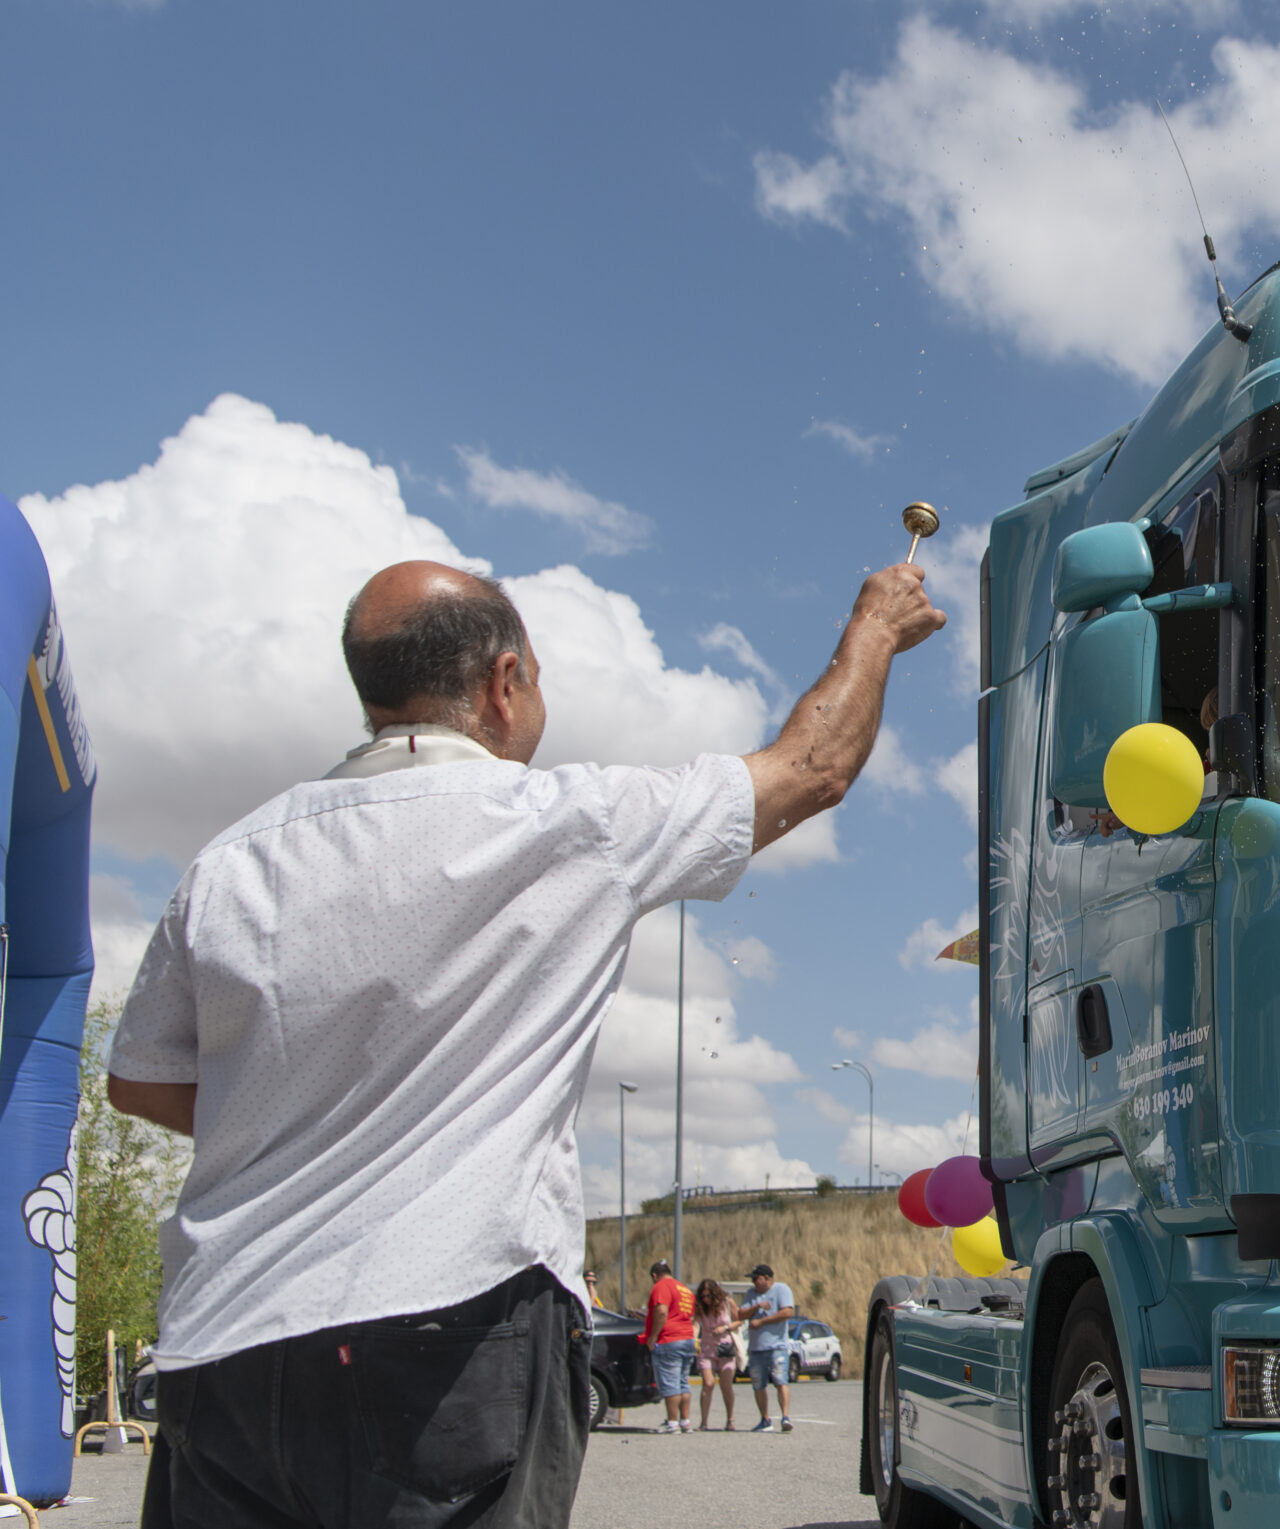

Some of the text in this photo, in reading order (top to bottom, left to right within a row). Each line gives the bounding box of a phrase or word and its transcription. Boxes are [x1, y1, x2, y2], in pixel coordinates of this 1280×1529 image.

[1169, 1025, 1210, 1052] Marinov
[1133, 1083, 1194, 1121] 630 199 340
